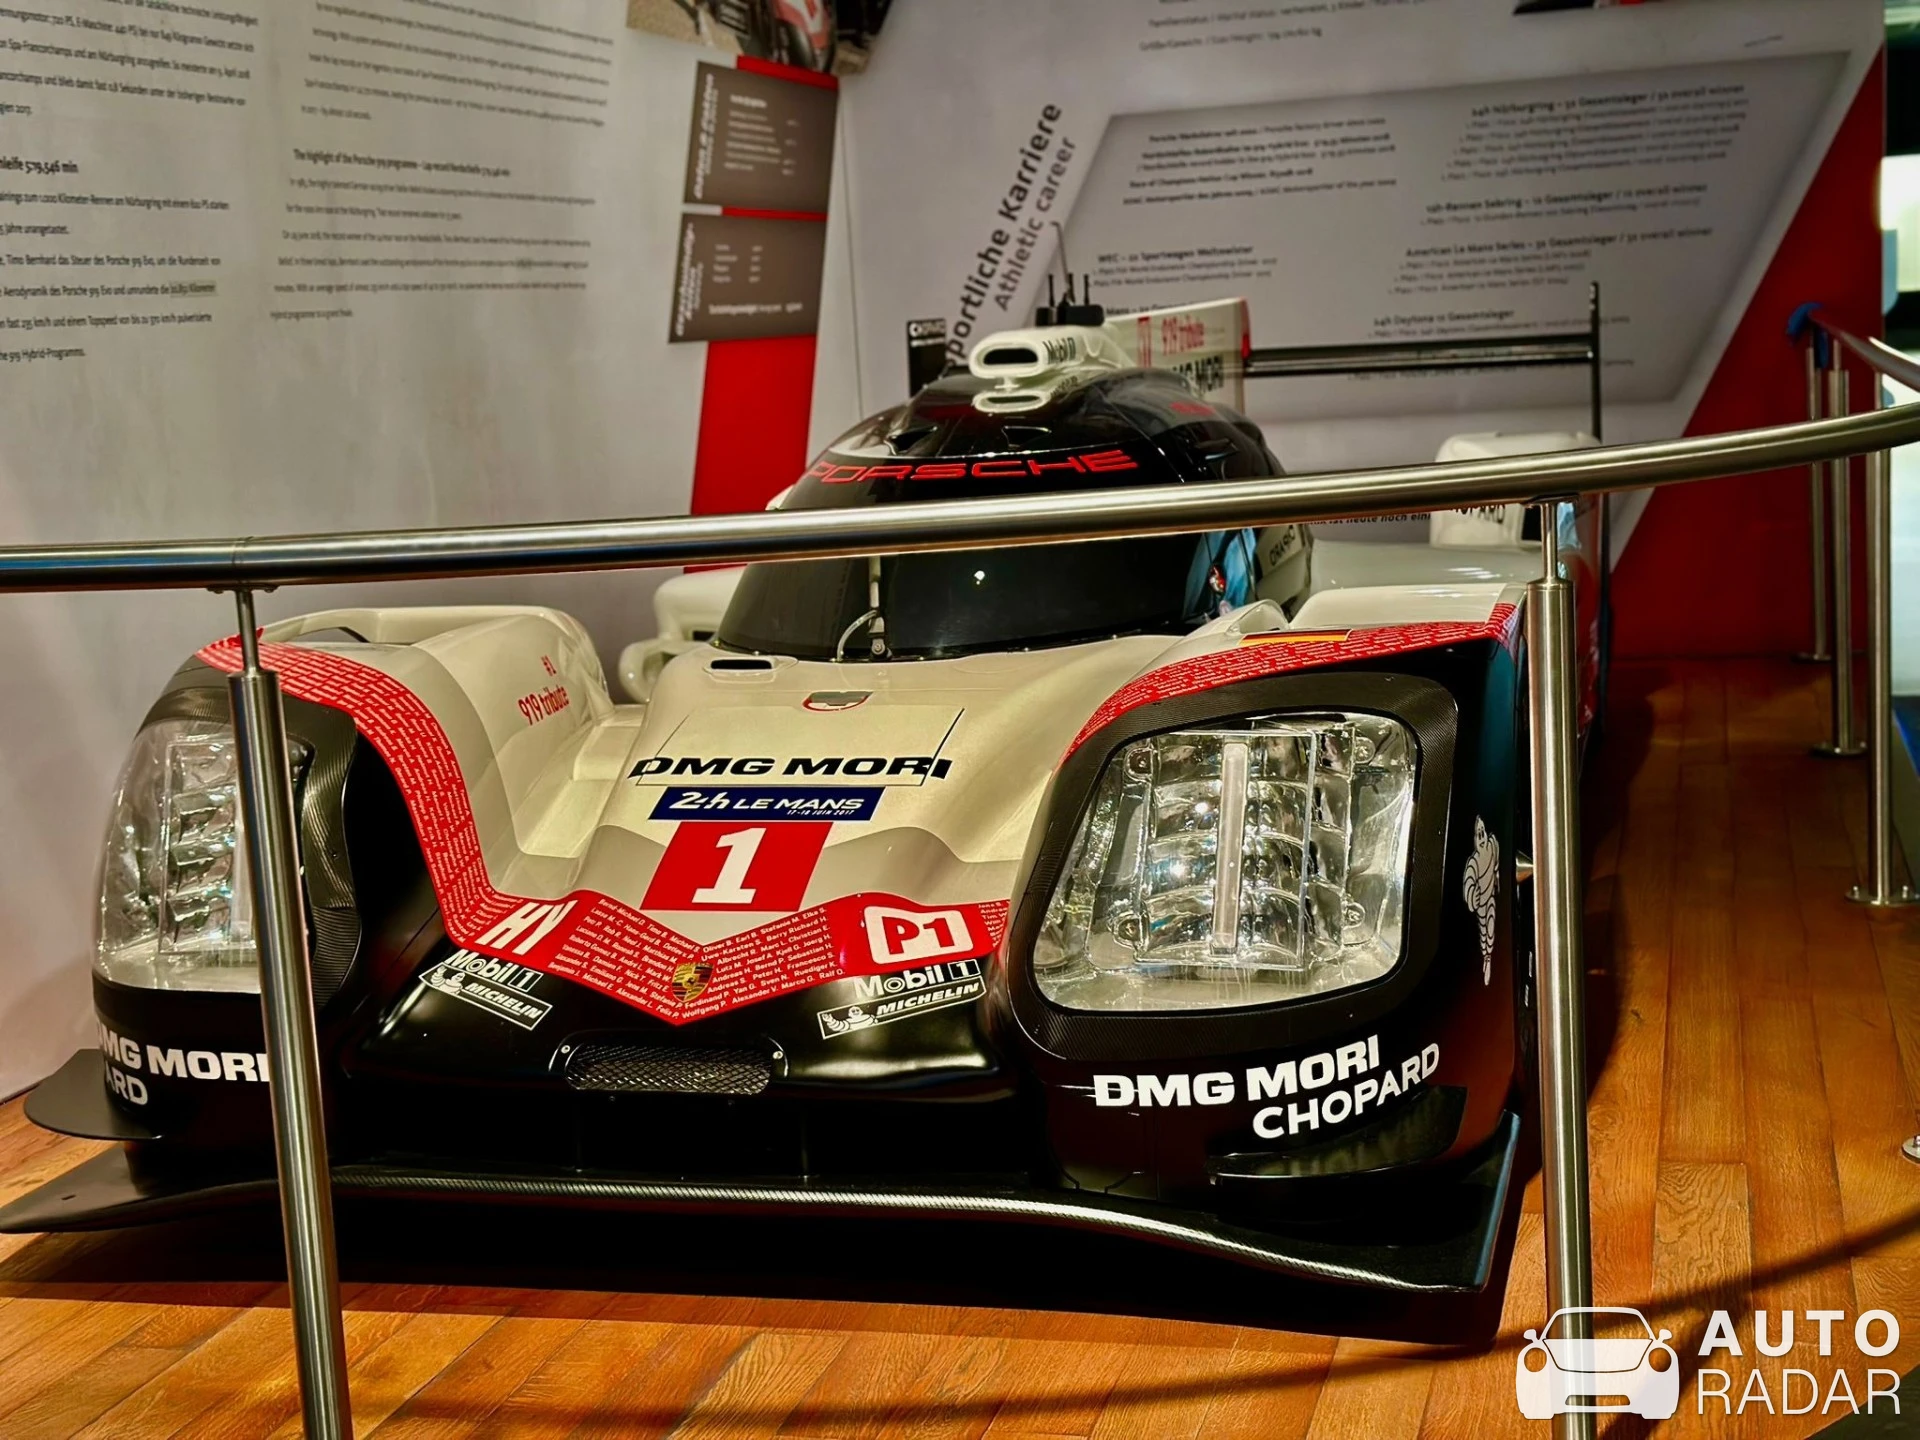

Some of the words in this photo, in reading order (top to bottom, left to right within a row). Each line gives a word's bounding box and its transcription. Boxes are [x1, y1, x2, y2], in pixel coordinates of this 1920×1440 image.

[998, 102, 1063, 221] Karriere
[994, 217, 1043, 312] Athletic
[1036, 136, 1076, 213] career
[806, 450, 1139, 484] PORSCHE
[627, 756, 776, 779] DMG
[782, 756, 954, 780] MORI
[732, 798, 774, 810] LE
[774, 798, 866, 810] MANS
[692, 827, 767, 905] 1
[474, 899, 580, 957] HY
[670, 935, 694, 950] Michael
[701, 943, 754, 961] Uwe-Karsten
[766, 931, 787, 941] Barry
[788, 919, 818, 933] Richard
[703, 943, 724, 953] Oliver
[760, 921, 791, 934] Stefanie
[802, 911, 818, 919] Elke
[717, 952, 748, 965] Albrecht
[760, 943, 779, 952] Marc
[788, 928, 822, 942] Christian
[882, 915, 956, 955] P1
[445, 949, 520, 984] Mobil
[515, 970, 534, 989] 1
[707, 981, 738, 993] Andreas
[752, 971, 773, 980] Peter
[787, 955, 826, 969] Francesco
[712, 971, 742, 983] Andreas
[755, 960, 777, 970] Bernd
[787, 946, 824, 961] Sebastian
[747, 954, 765, 965] Josef
[465, 981, 545, 1020] MICHELIN
[682, 1004, 718, 1018] Wolfgang
[732, 989, 769, 1003] Alexander
[781, 979, 805, 989] Marco
[819, 970, 834, 979] Ralf
[684, 993, 722, 1009] Ferdinand
[760, 977, 779, 986] Sven
[794, 964, 827, 976] Ruediger
[853, 964, 945, 1000] Mobil
[957, 961, 971, 978] 1
[876, 981, 981, 1015] MICHELIN
[99, 1022, 142, 1070] MG
[146, 1044, 271, 1083] MORI
[1093, 1071, 1236, 1107] DMG
[1246, 1034, 1381, 1102] MORI
[1252, 1042, 1441, 1139] CHOPARD
